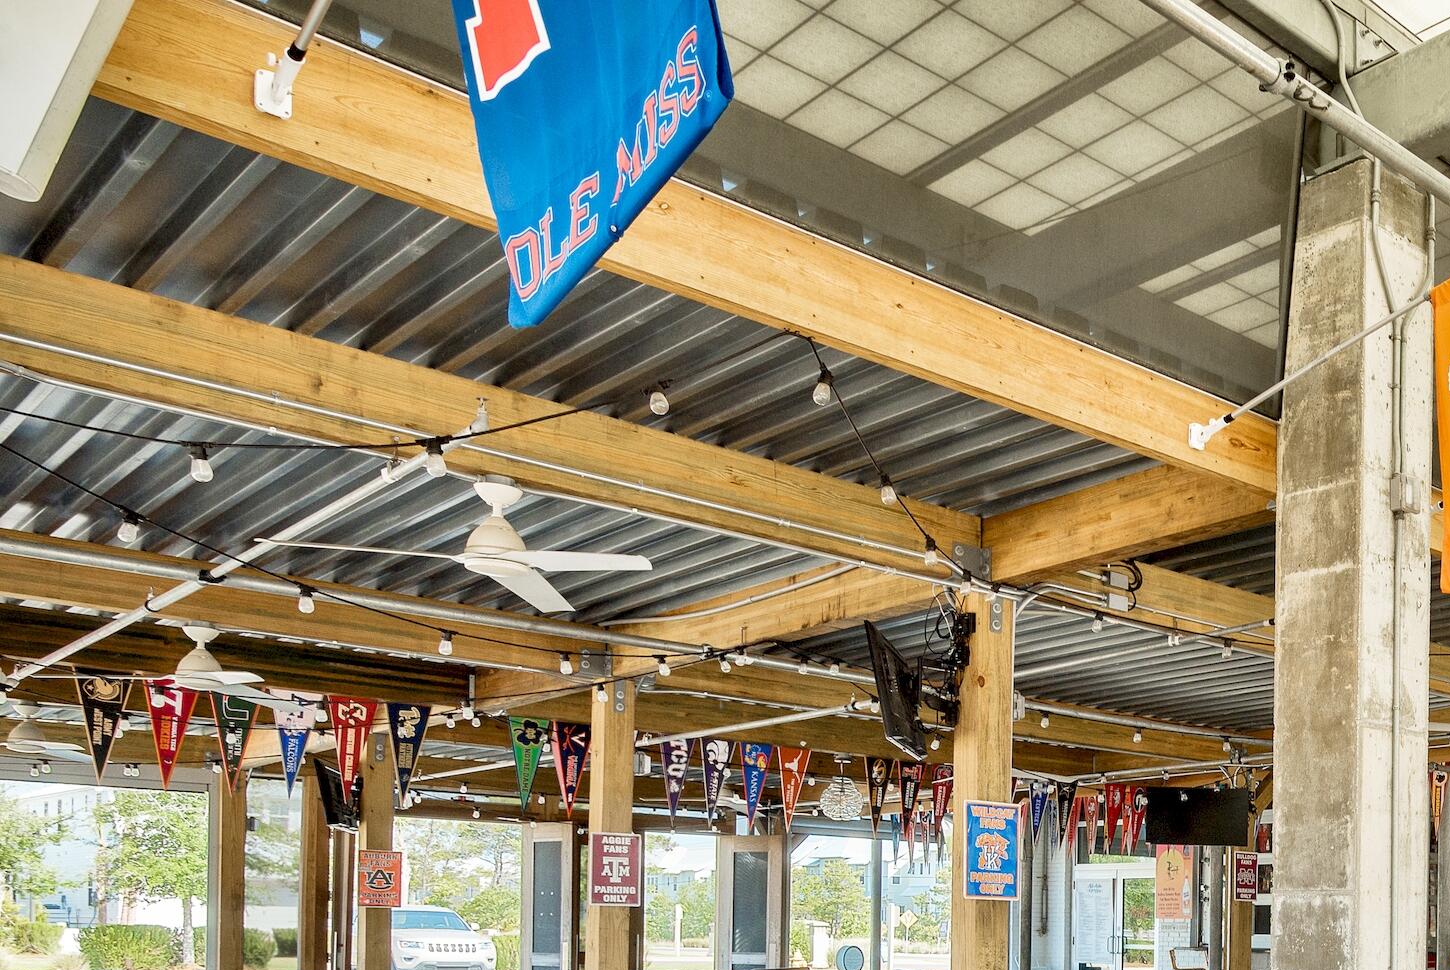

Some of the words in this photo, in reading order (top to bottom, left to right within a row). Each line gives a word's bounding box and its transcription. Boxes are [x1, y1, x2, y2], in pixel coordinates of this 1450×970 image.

[505, 171, 599, 302] OLE
[610, 25, 706, 207] MISS
[286, 738, 297, 773] FALCONS
[523, 748, 531, 771] NOTRE
[667, 738, 689, 778] TCU
[522, 772, 530, 792] DAME
[710, 771, 720, 801] K-STATE
[749, 770, 759, 803] KANSAS
[970, 805, 1016, 819] WILDCAT
[980, 818, 1006, 830] FANS
[602, 836, 631, 845] AGGIE
[603, 845, 629, 853] FANS
[970, 871, 1015, 885] PARKING
[594, 886, 636, 895] PARKING
[979, 883, 1006, 895] ONLY
[603, 894, 628, 903] ONLY
